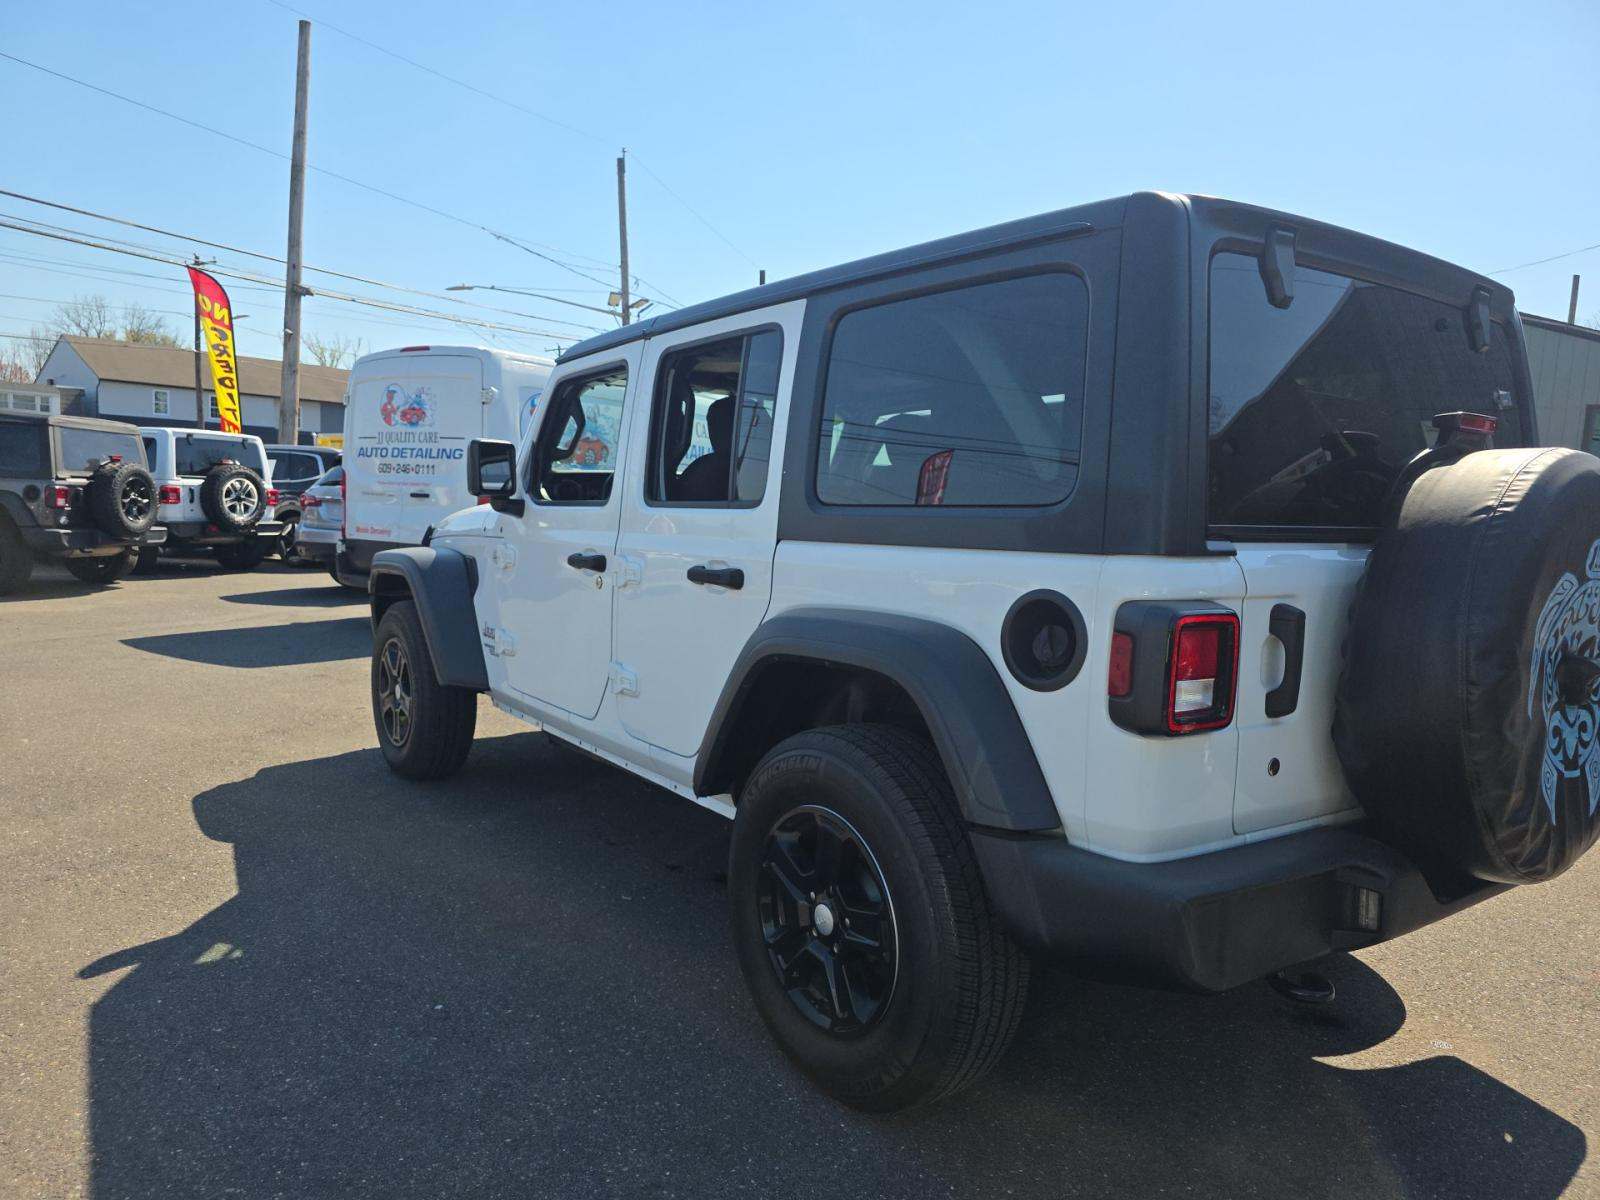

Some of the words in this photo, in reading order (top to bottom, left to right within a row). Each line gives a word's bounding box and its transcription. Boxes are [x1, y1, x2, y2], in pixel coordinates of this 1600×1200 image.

[385, 432, 417, 445] QUALITY
[418, 432, 439, 444] CARE
[358, 447, 389, 458] AUTO
[391, 448, 464, 459] DETAILING
